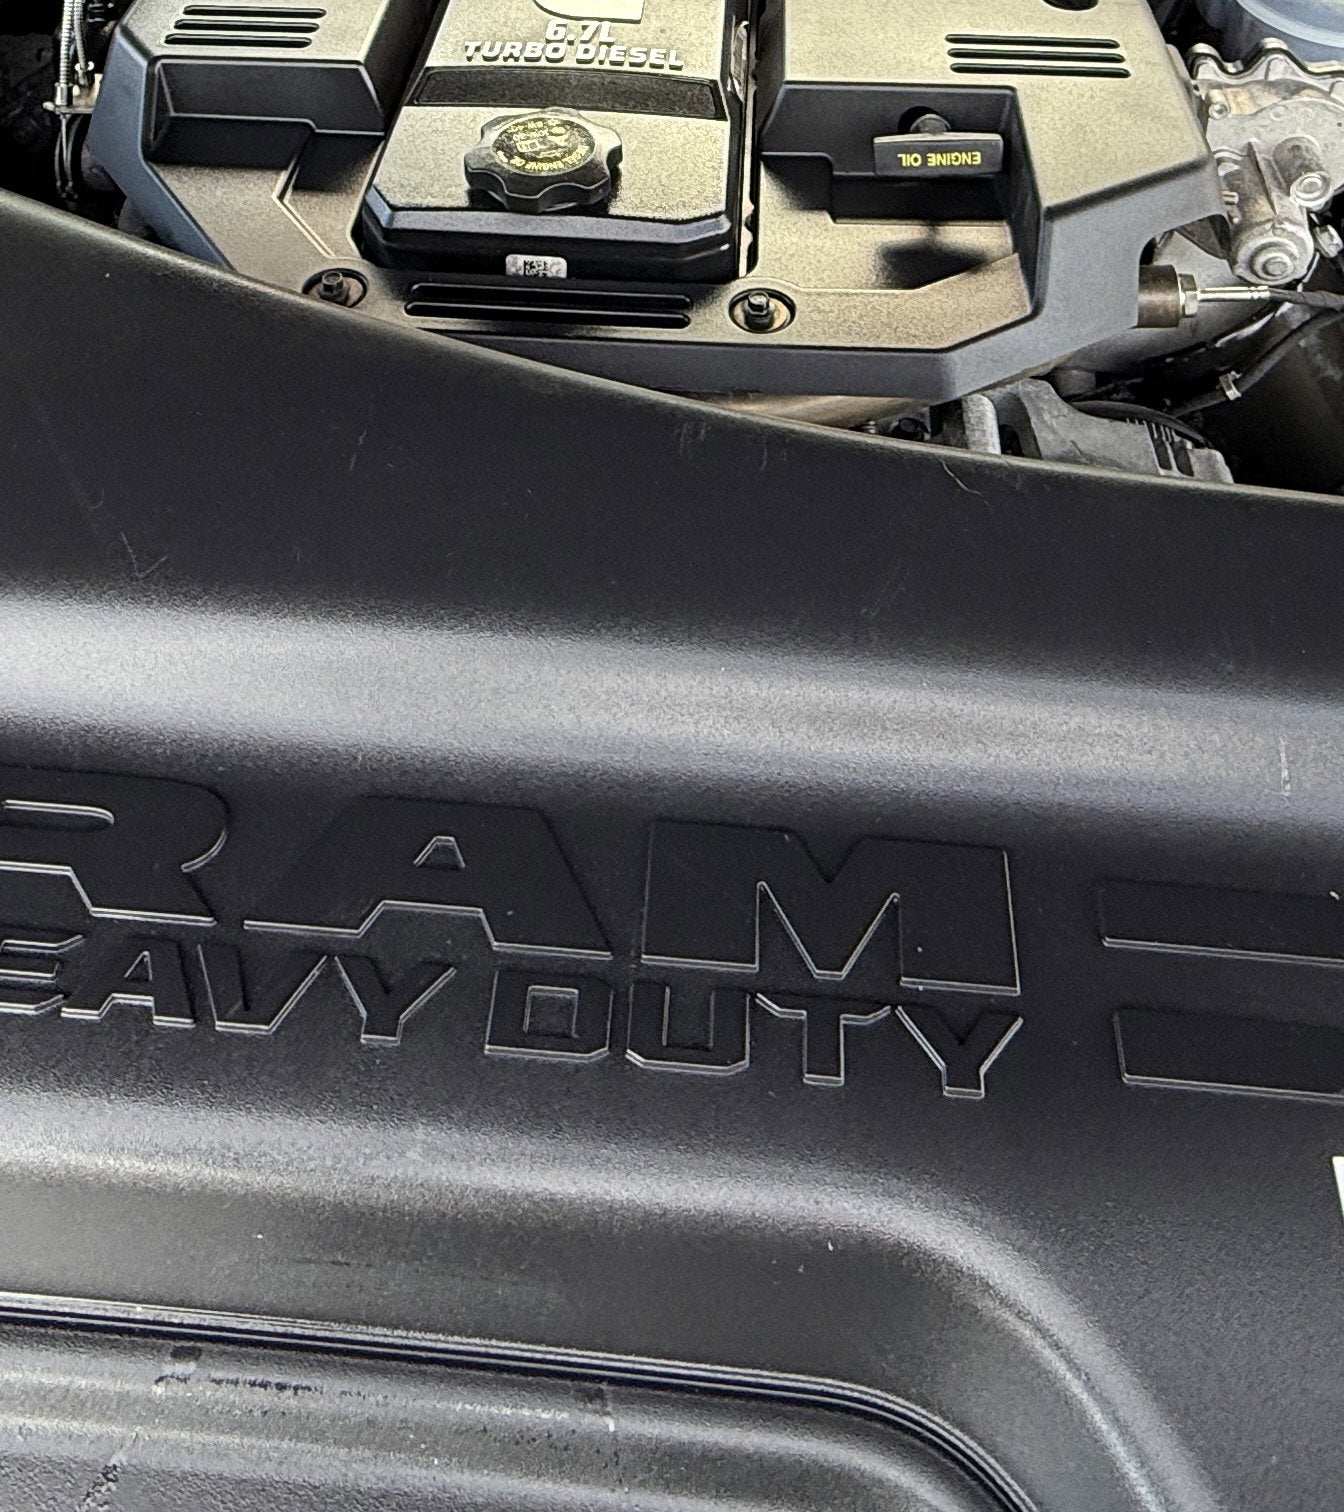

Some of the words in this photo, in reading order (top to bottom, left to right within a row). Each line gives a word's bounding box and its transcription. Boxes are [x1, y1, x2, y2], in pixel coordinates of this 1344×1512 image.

[545, 19, 615, 46] 6.7L
[465, 40, 568, 64] TURBO
[575, 44, 684, 70] DIESEL
[897, 153, 922, 167] OIL
[926, 151, 982, 167] ENGINE
[483, 968, 1024, 1100] DUTY
